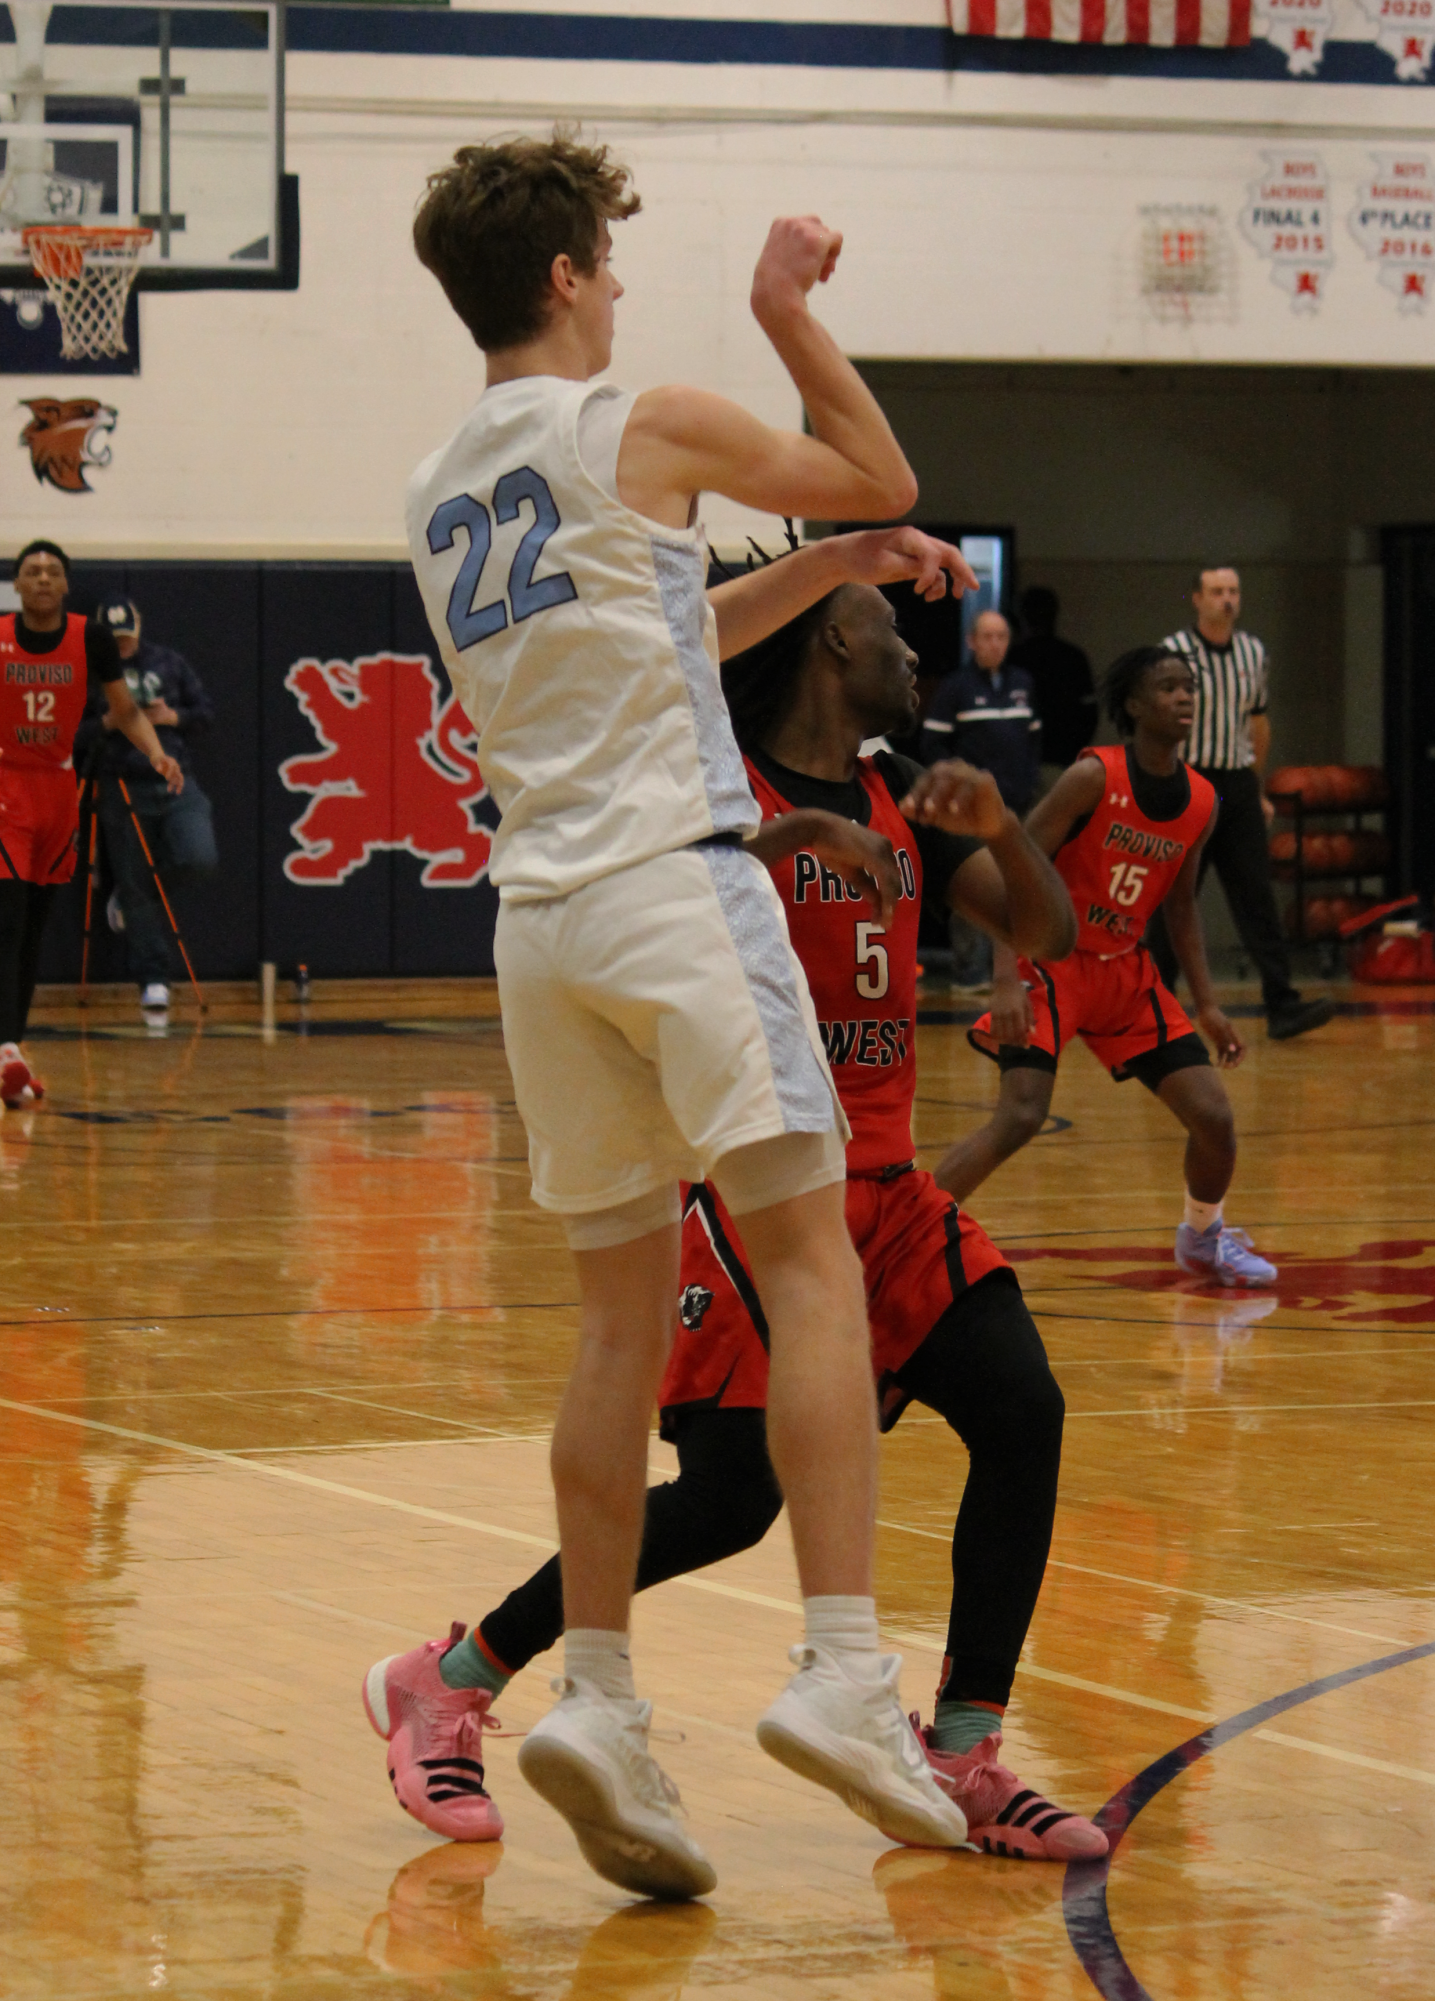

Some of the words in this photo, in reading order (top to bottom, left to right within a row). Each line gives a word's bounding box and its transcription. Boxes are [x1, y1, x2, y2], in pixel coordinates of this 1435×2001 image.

[1380, 0, 1432, 19] 2020
[1253, 208, 1304, 226] FINAL
[1311, 209, 1320, 226] 4
[1380, 210, 1432, 230] PLACE
[1274, 232, 1324, 252] 2015
[1380, 237, 1433, 257] 2016
[426, 465, 579, 653] 22
[5, 662, 73, 684] PROVISO
[22, 690, 55, 722] 12
[16, 726, 58, 745] WEST
[1105, 823, 1184, 862] PROVISO
[1109, 862, 1149, 906] 15
[855, 921, 889, 999] 5
[817, 1018, 910, 1067] WEST
